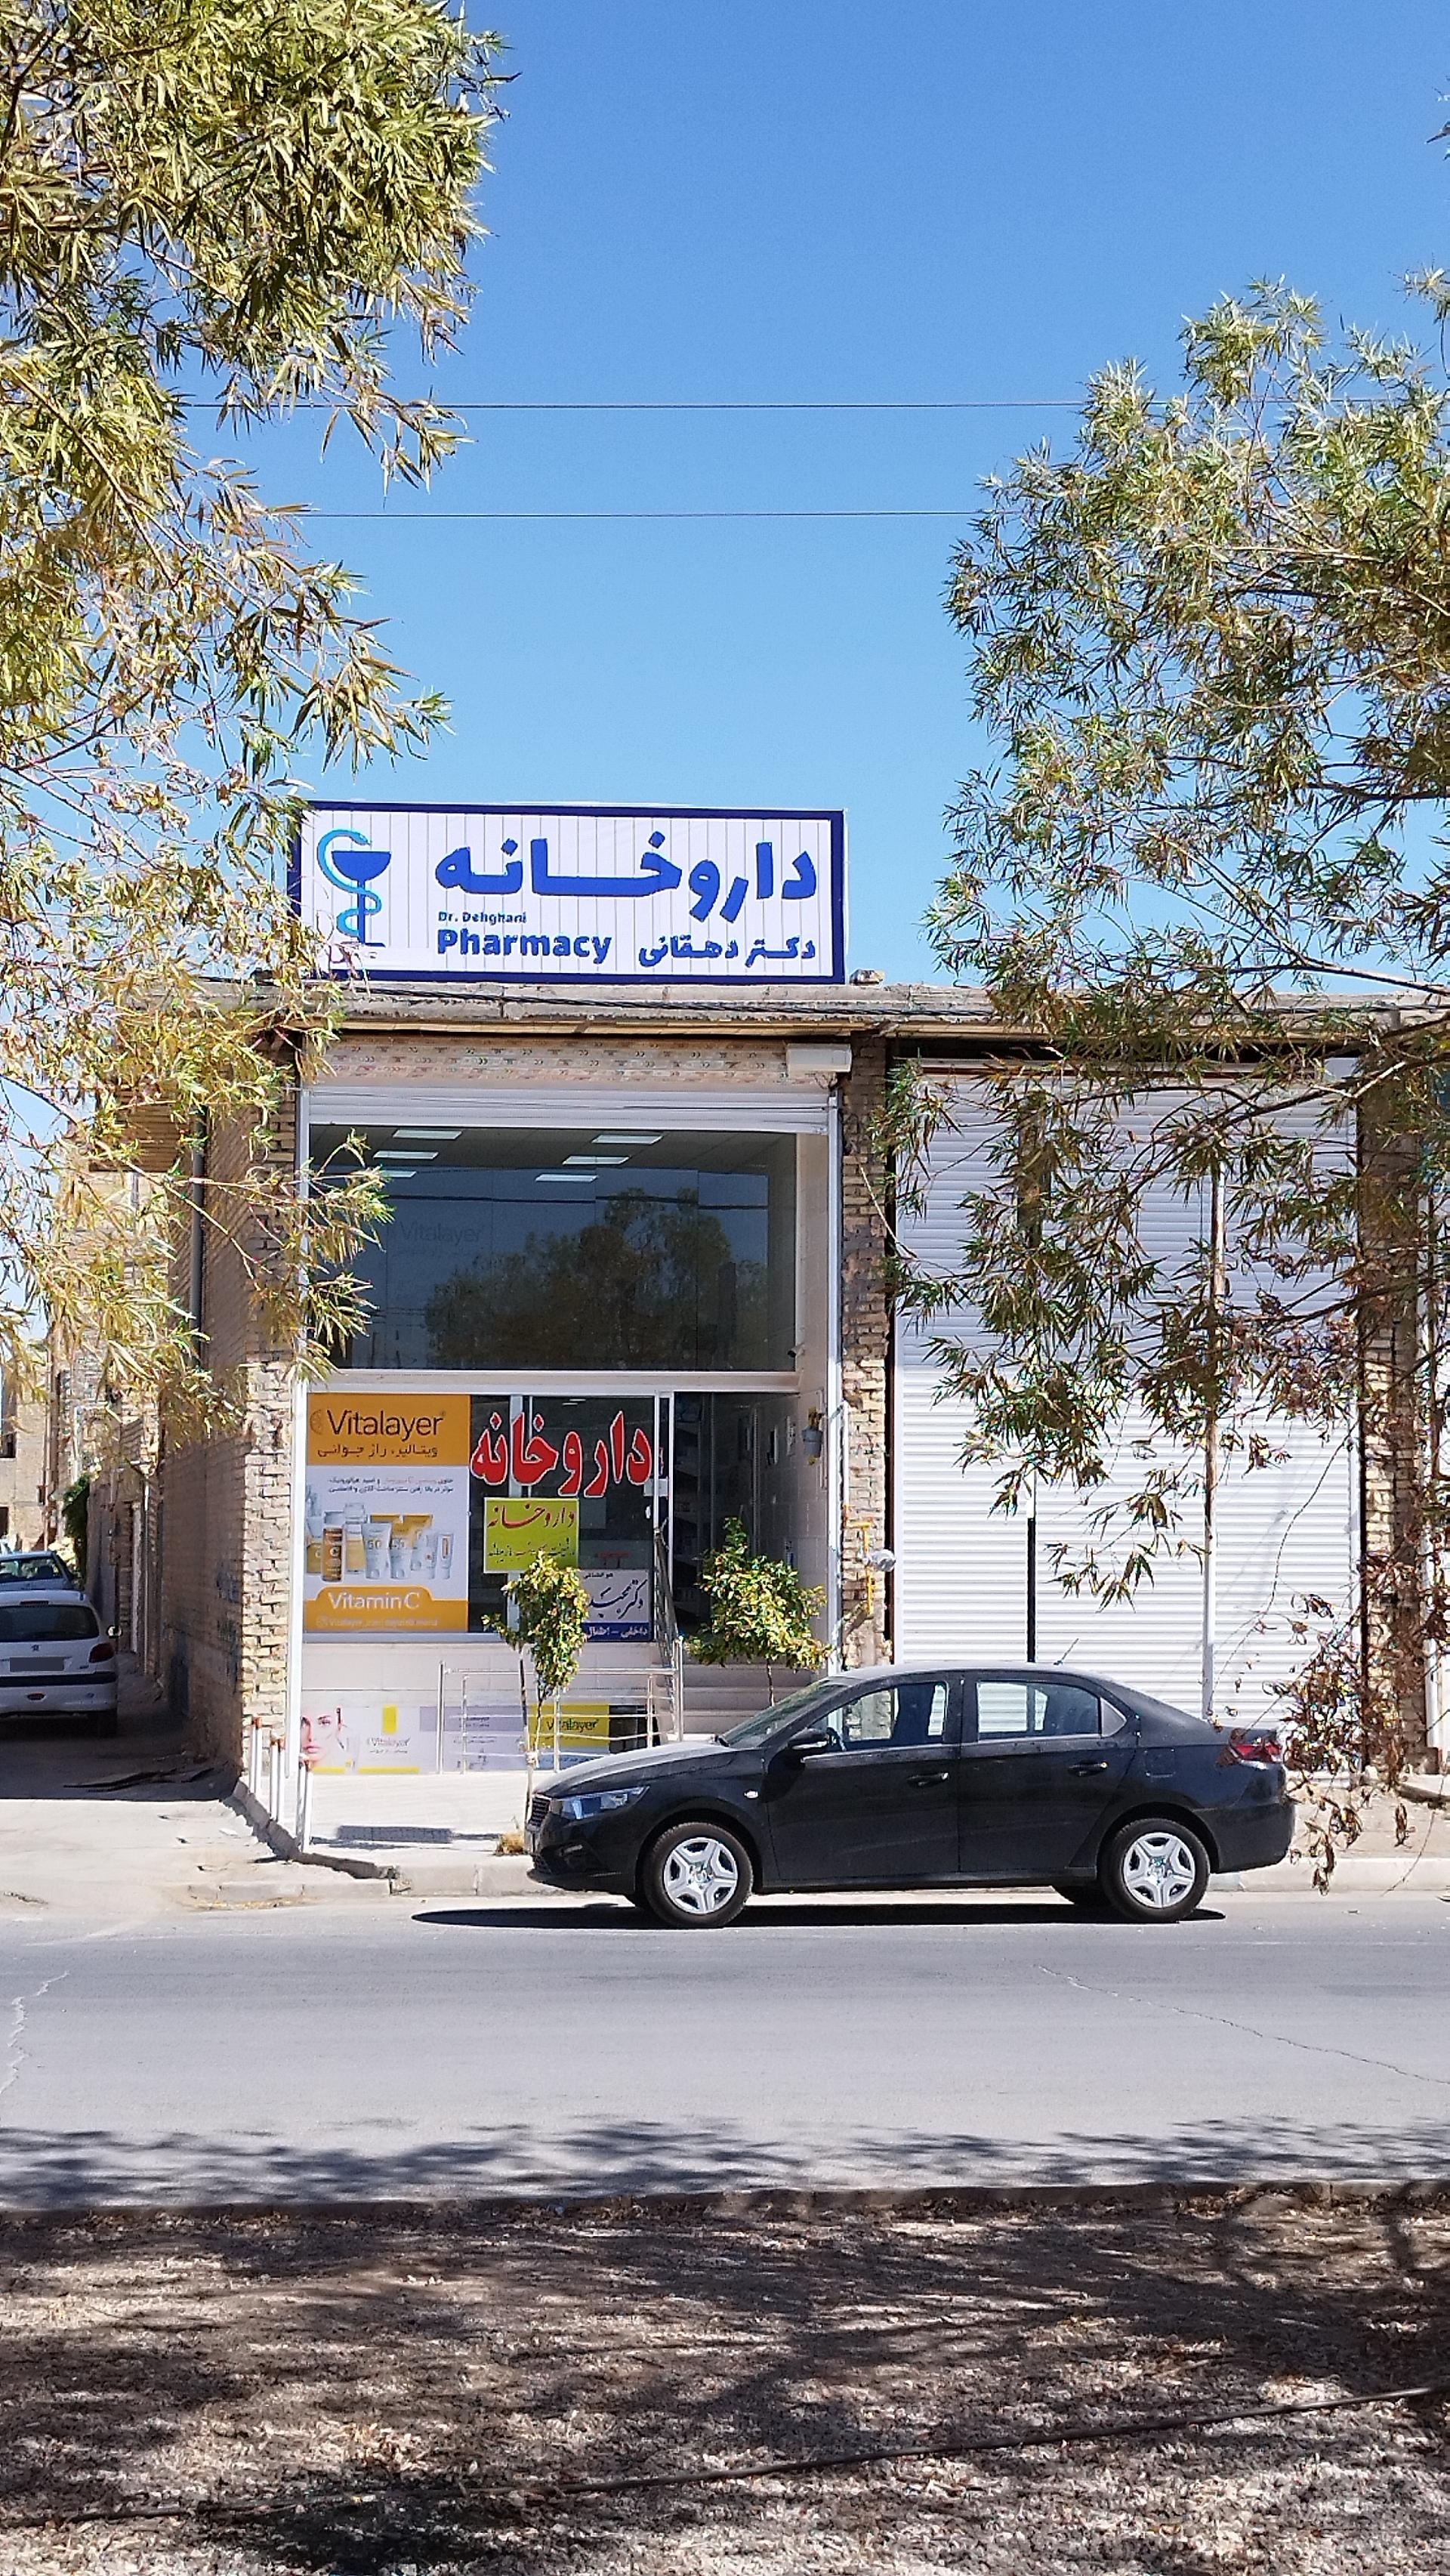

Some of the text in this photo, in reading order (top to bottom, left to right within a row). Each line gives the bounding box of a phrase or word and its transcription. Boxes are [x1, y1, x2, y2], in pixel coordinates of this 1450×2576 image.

[436, 831, 816, 924] داروخانه
[438, 911, 526, 925] Dr. Dehghani
[437, 928, 612, 964] Pharmacy
[639, 934, 816, 968] دکتر دهقانی
[326, 1409, 443, 1442] Vitalayer
[317, 1444, 364, 1458] جوانی
[470, 1410, 652, 1497] داروخانه
[327, 1591, 421, 1610] Vitamin C
[546, 1719, 597, 1733] Valayer
